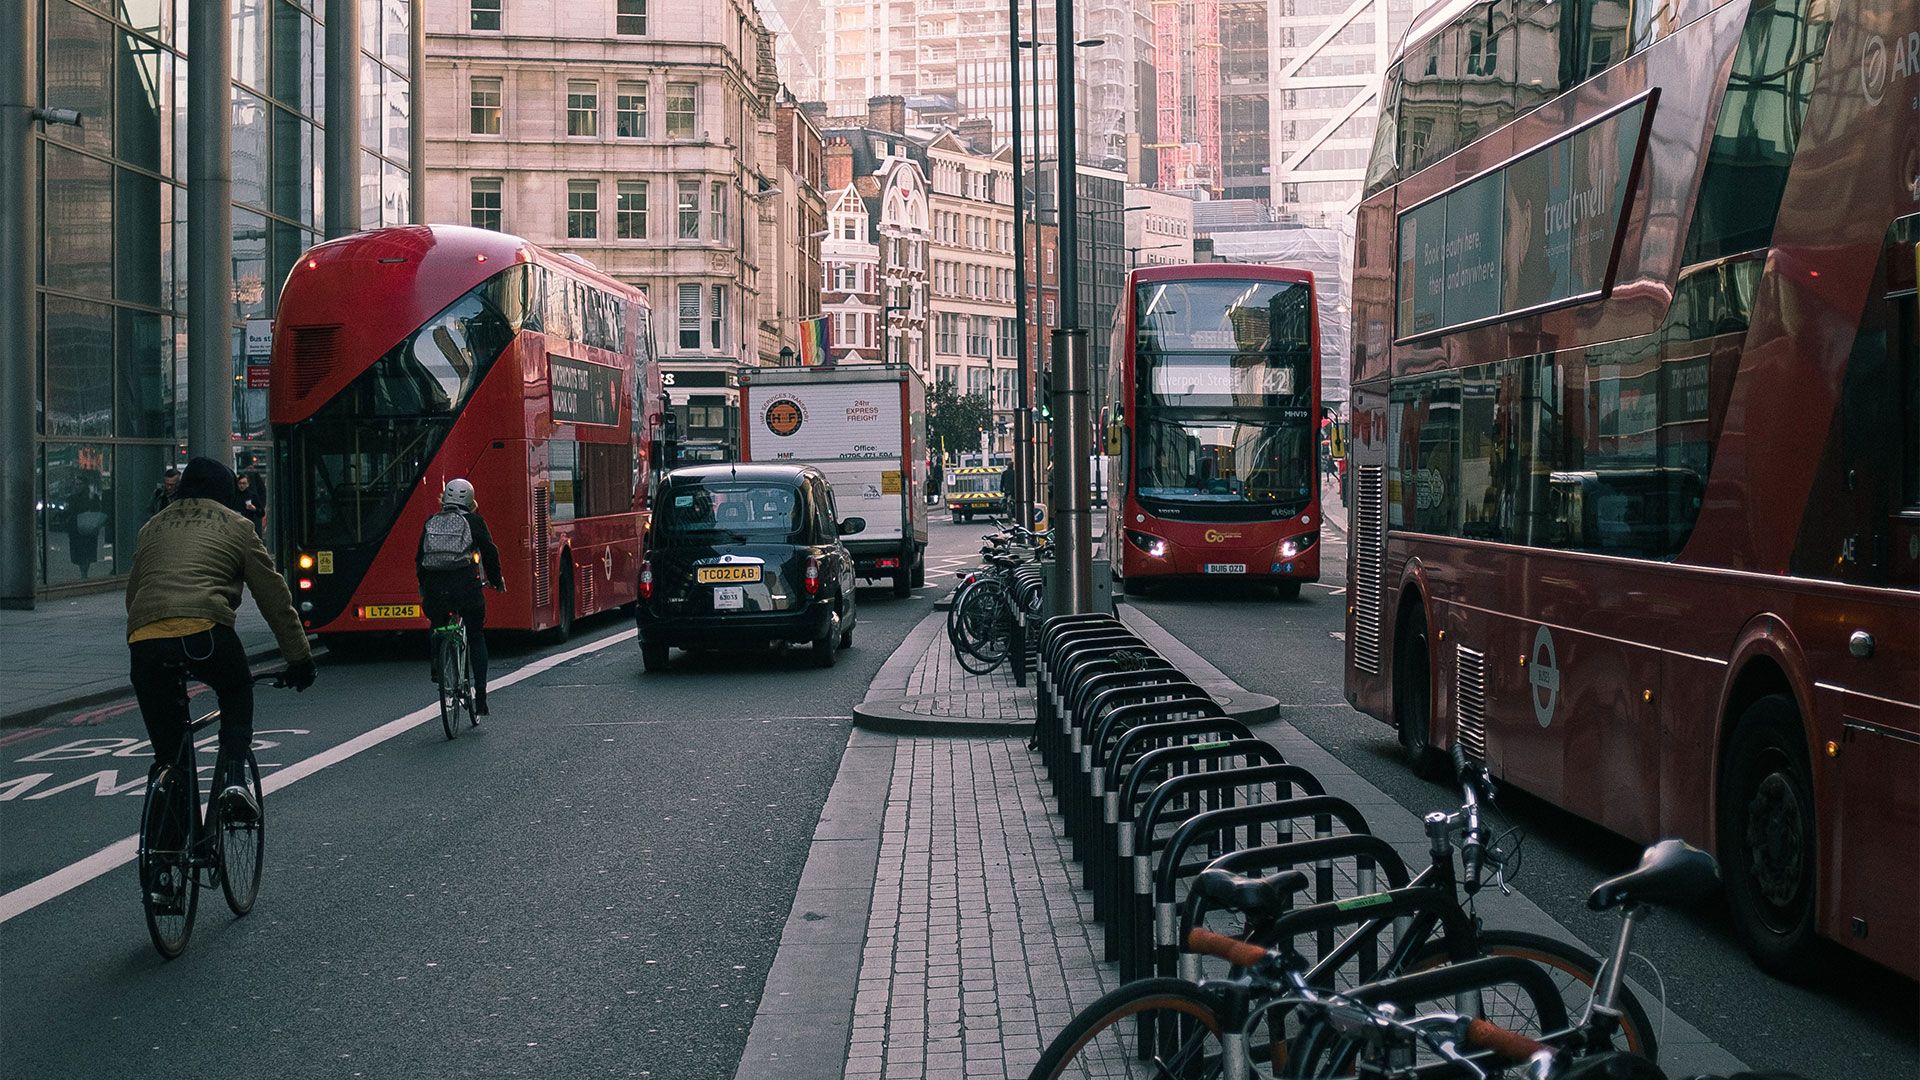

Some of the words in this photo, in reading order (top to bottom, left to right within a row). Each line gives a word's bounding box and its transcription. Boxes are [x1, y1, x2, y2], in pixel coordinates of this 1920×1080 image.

[1424, 240, 1440, 266] Book
[846, 407, 879, 415] EXPRESS
[702, 569, 731, 579] TC02
[733, 569, 755, 579] CAB
